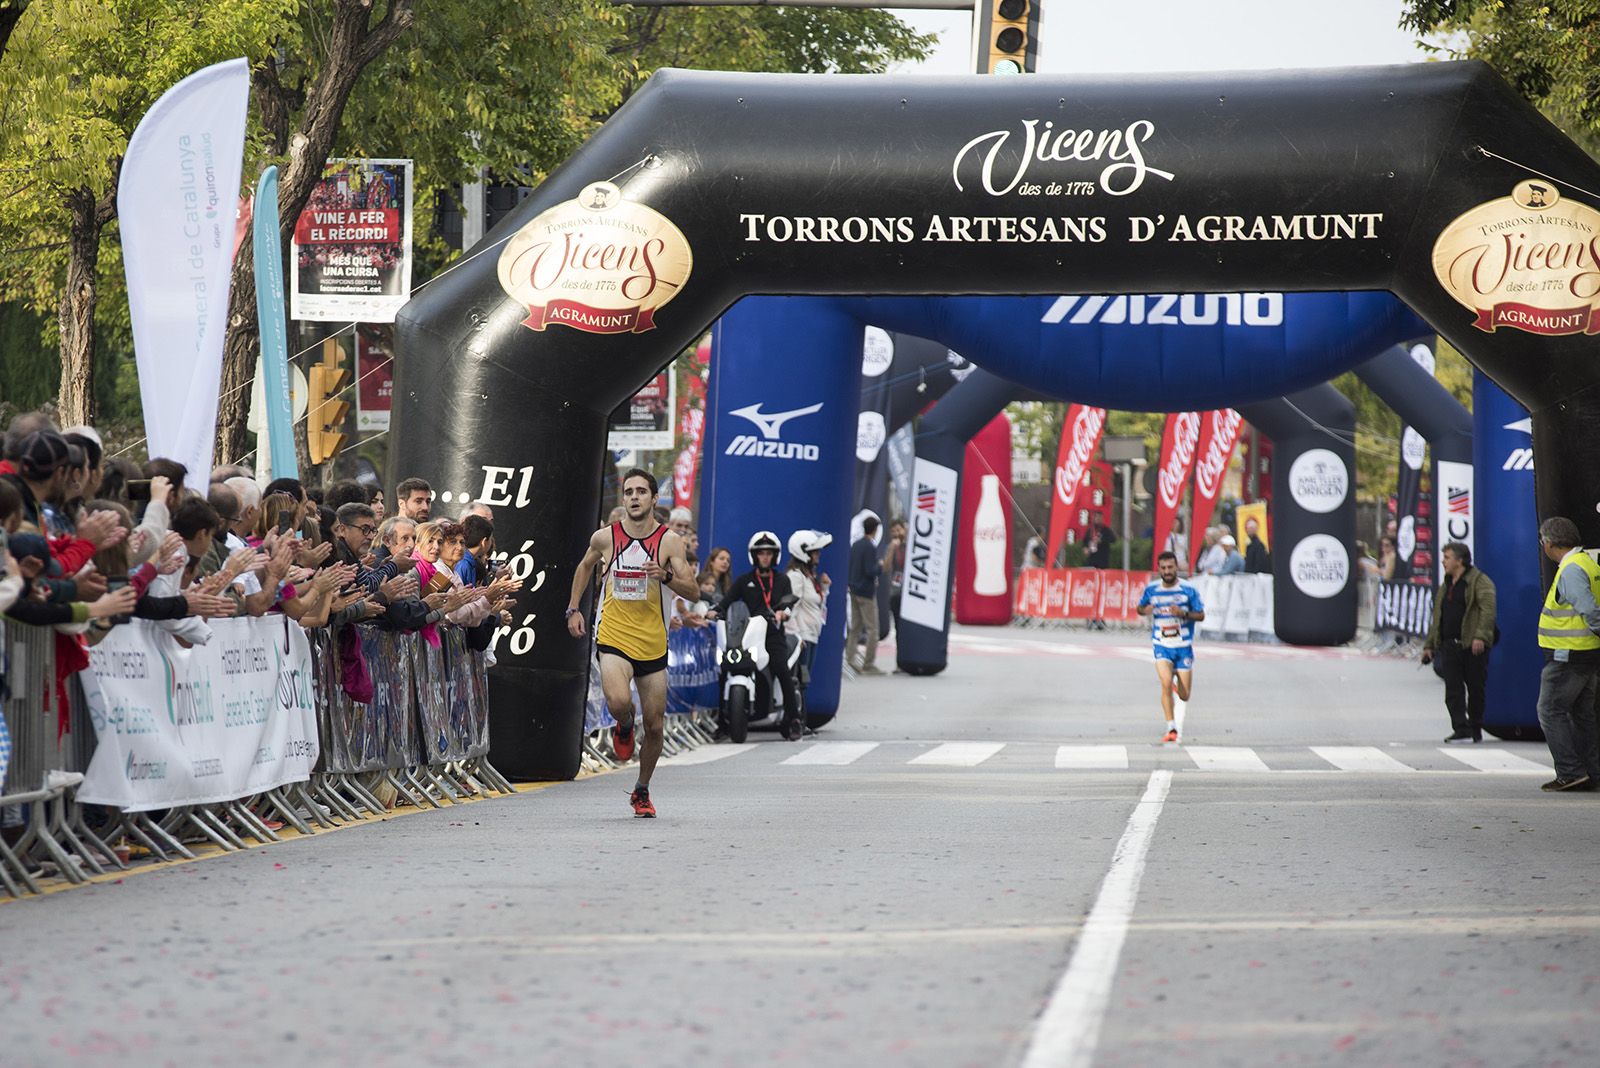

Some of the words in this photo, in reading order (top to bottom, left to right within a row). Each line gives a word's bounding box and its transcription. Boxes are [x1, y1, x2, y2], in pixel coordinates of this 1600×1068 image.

[179, 135, 200, 238] Catalunya
[1019, 182, 1041, 196] des
[1045, 182, 1063, 196] de
[1065, 182, 1095, 196] 1775
[314, 212, 345, 225] VINE
[348, 212, 357, 224] A
[360, 211, 385, 224] FER
[1478, 216, 1534, 236] TORRONS
[1536, 214, 1592, 234] ARTESANS
[311, 229, 326, 241] EL
[739, 213, 914, 243] TORRONS
[922, 214, 1107, 243] ARTESANS
[189, 245, 206, 269] de
[352, 256, 372, 266] QUE
[323, 267, 344, 276] UNA
[346, 267, 379, 277] CURSA
[595, 280, 617, 291] 1775
[1541, 280, 1564, 291] 1775
[550, 307, 633, 327] AGRAMUNT
[1498, 310, 1583, 328] AGRAMUNT
[908, 515, 933, 600] FIATC
